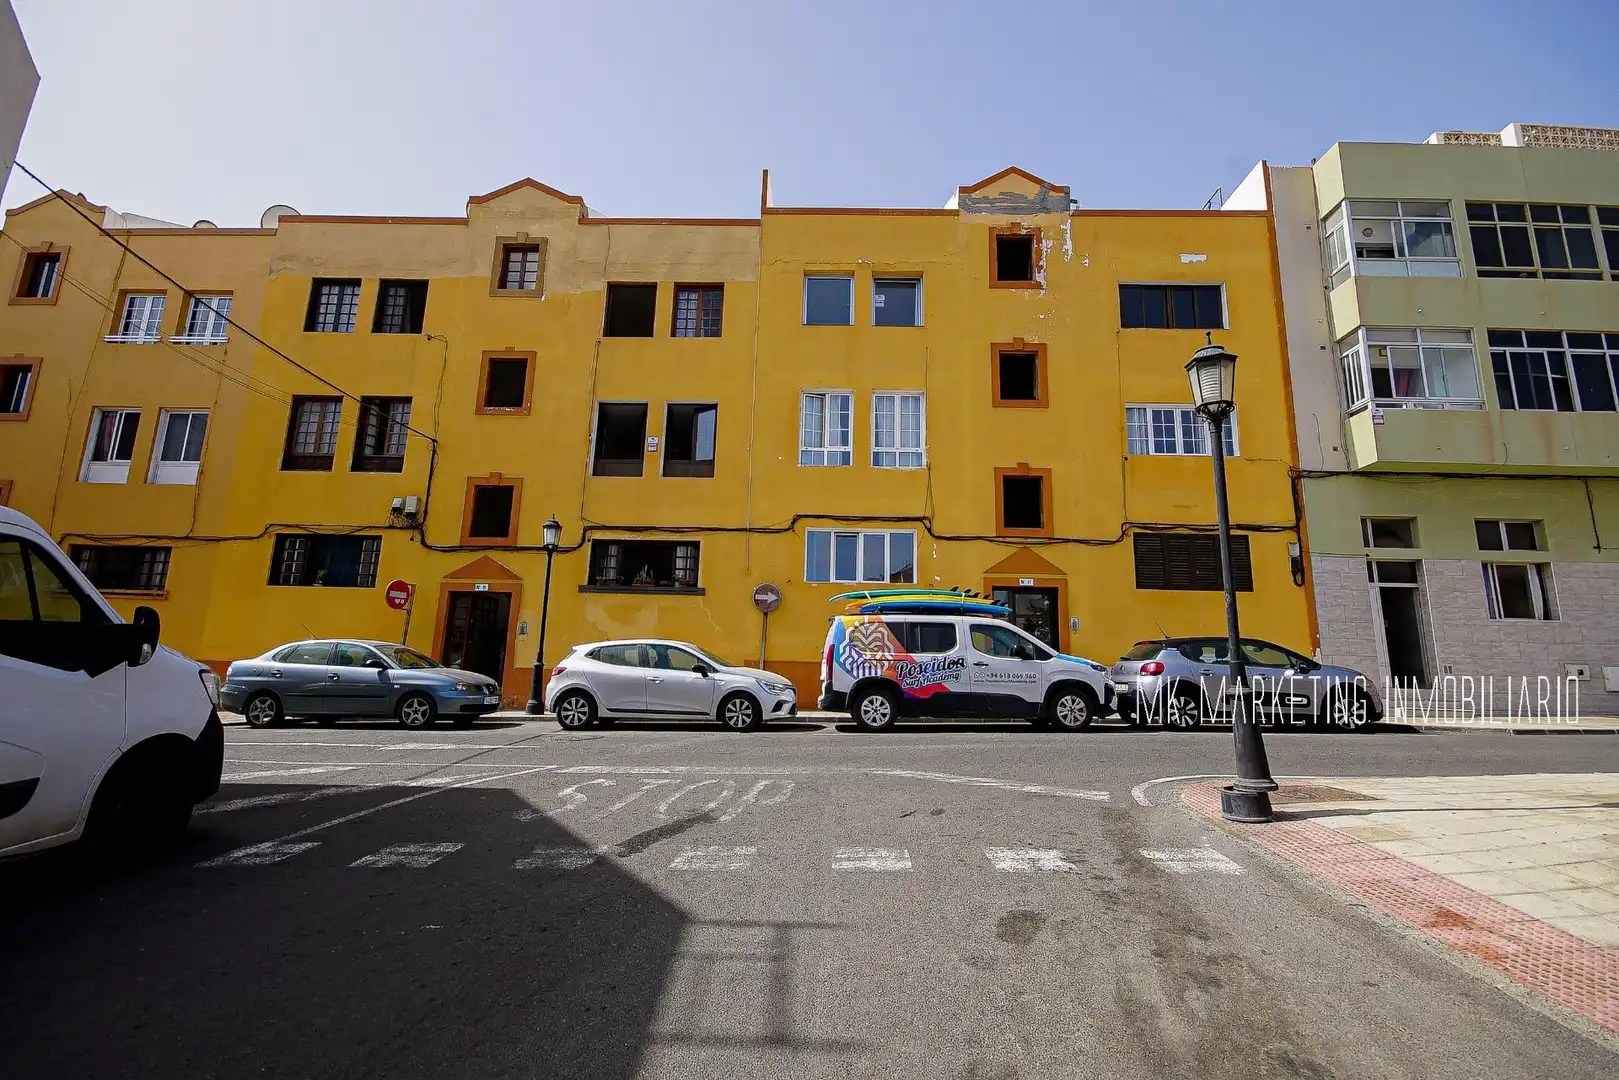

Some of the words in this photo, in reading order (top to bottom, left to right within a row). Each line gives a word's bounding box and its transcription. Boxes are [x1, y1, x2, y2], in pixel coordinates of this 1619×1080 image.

[896, 656, 967, 679] Poseidon
[902, 677, 920, 688] Surf
[921, 671, 961, 684] Academy
[512, 778, 796, 822] STOP
